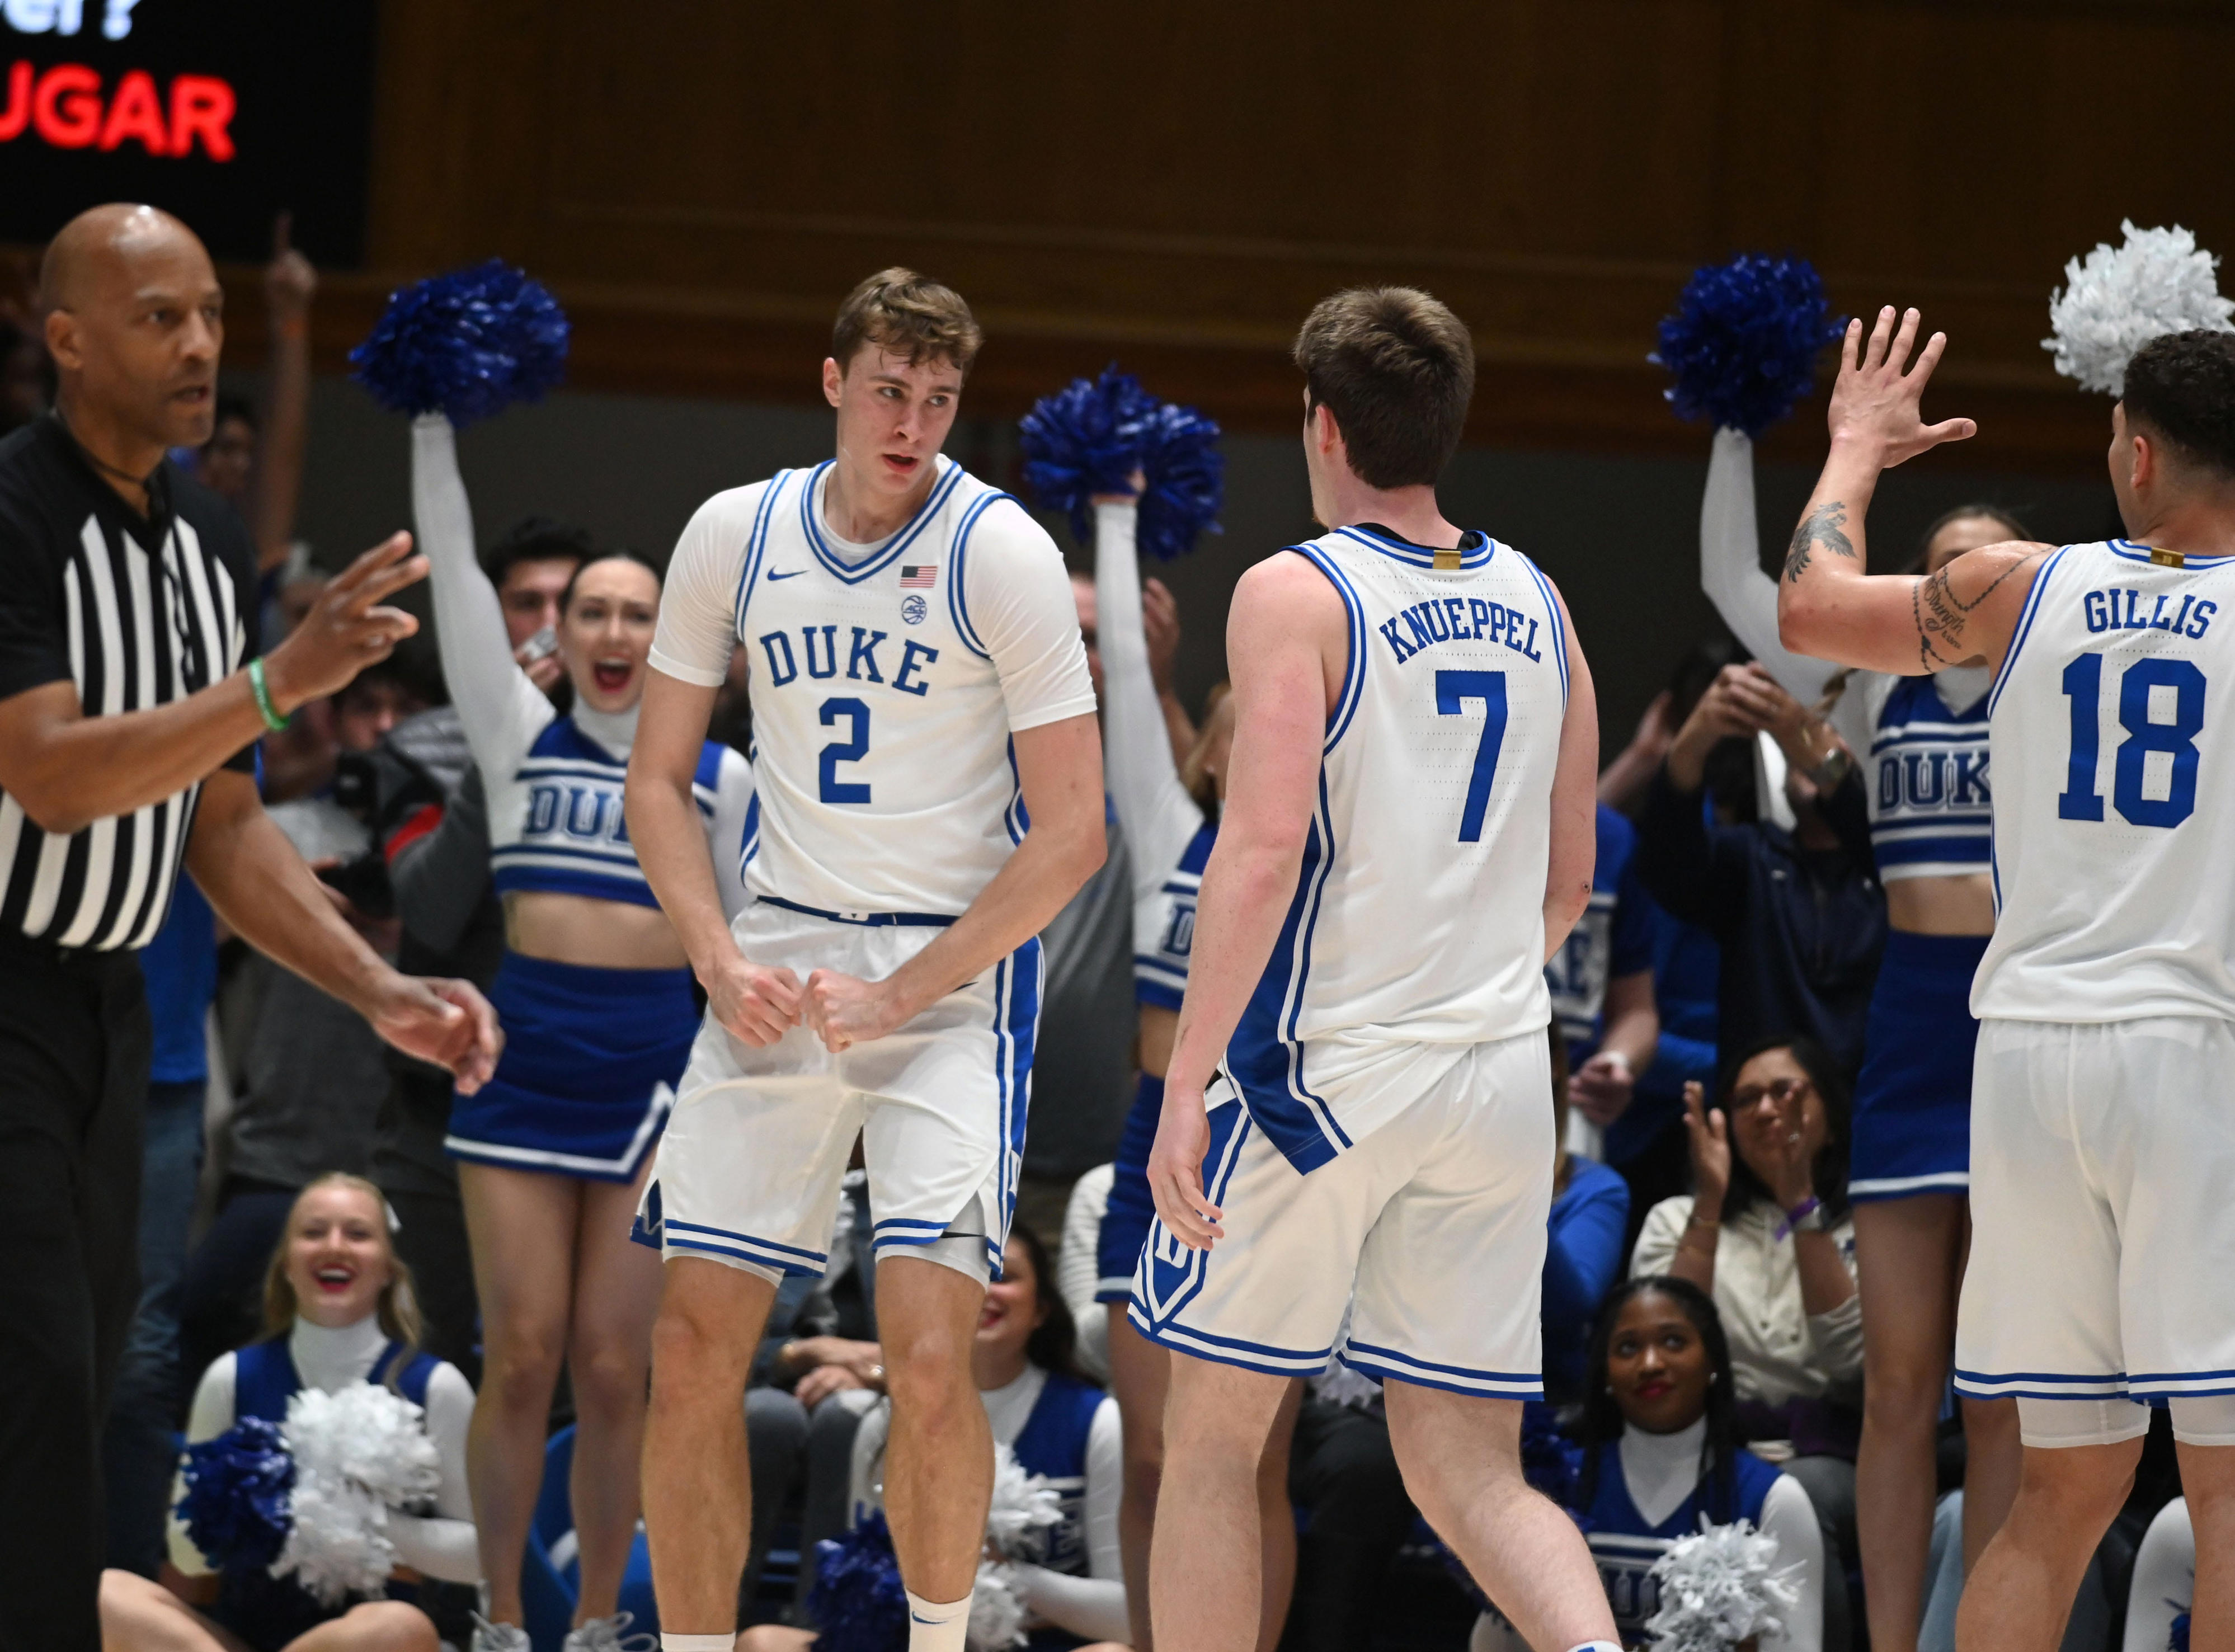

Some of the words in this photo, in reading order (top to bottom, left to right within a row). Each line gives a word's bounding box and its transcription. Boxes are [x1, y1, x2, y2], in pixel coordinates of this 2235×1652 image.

[1379, 597, 1541, 665] KNUEPPEL
[2084, 588, 2217, 639] GILLIS
[759, 624, 939, 697] DUKE
[818, 697, 872, 804] 2
[1435, 670, 1508, 843] 7
[2058, 652, 2207, 829] 18
